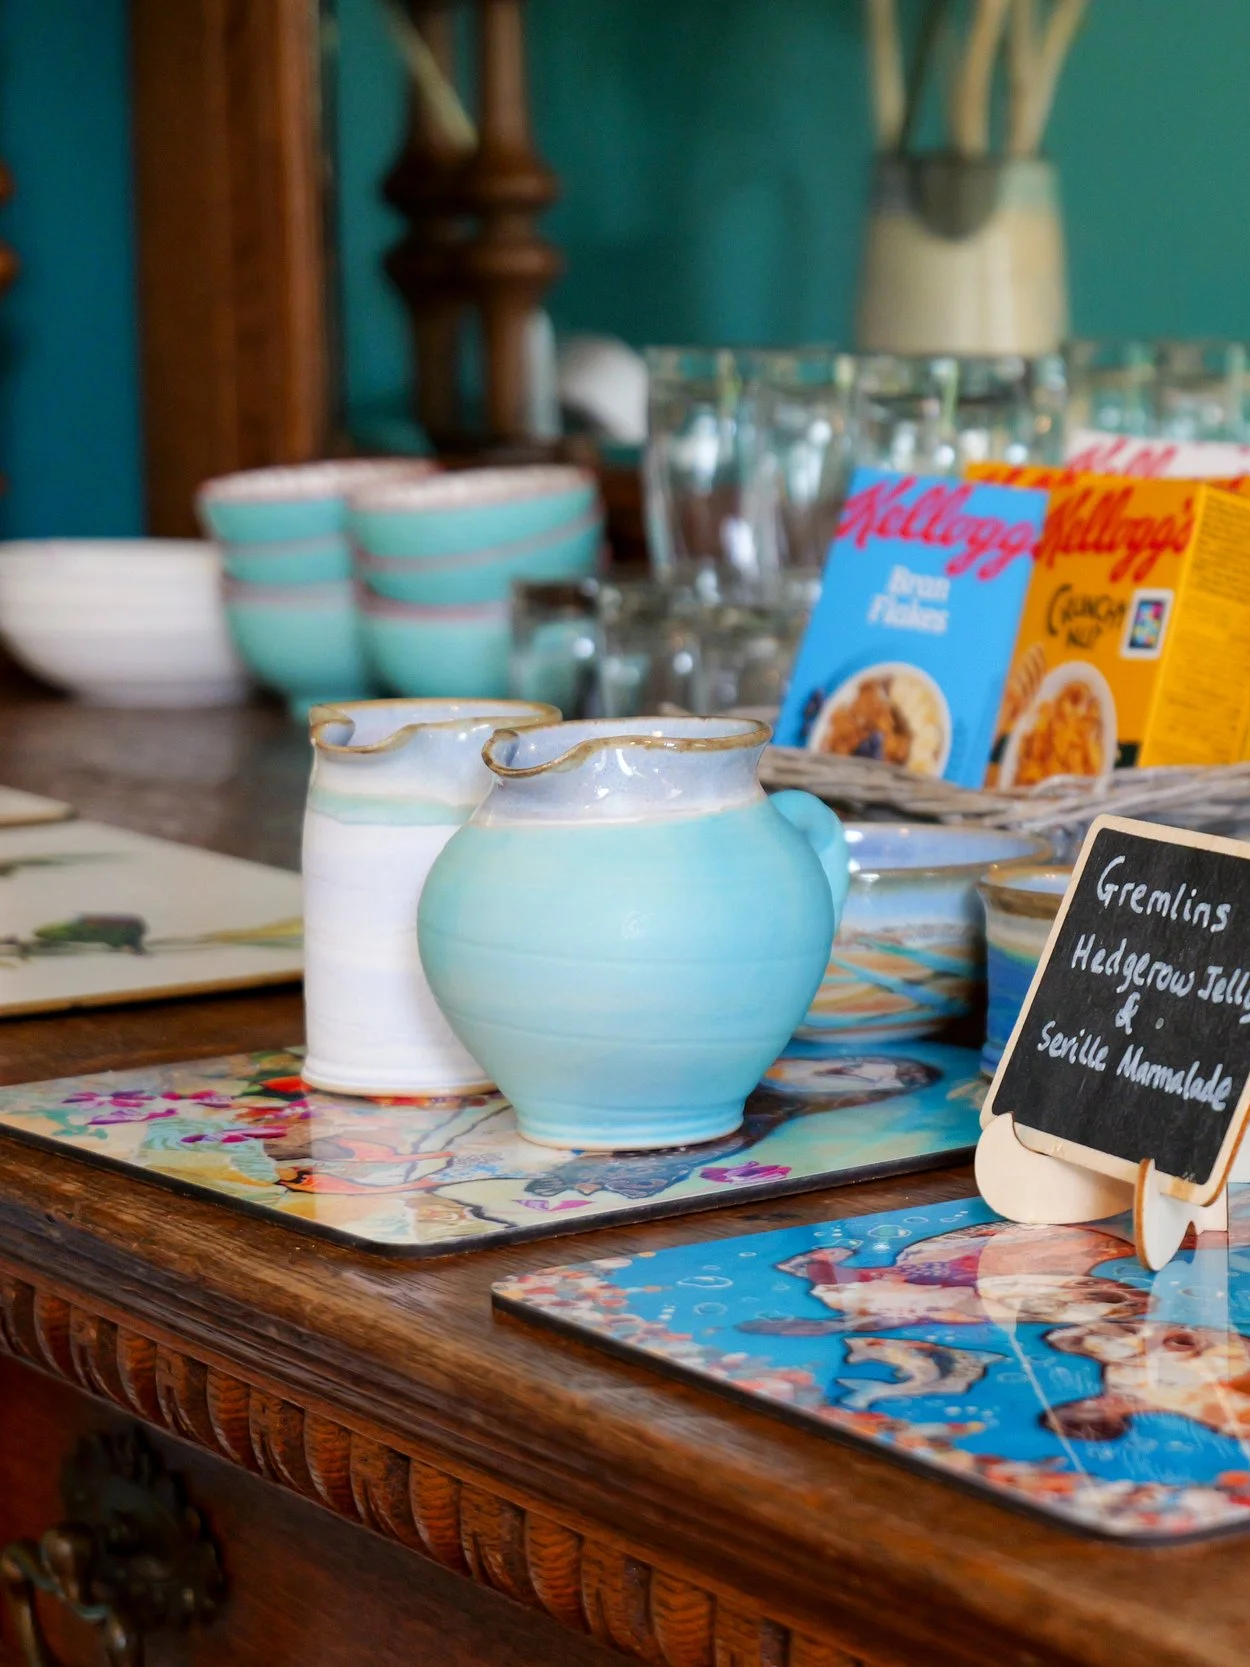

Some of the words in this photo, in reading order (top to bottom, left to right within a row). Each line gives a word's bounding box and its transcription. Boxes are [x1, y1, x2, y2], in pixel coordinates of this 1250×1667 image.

[1097, 855, 1231, 933] Gremlins
[1071, 934, 1195, 997] Hedgerow
[1115, 992, 1141, 1035] &
[1037, 1020, 1109, 1071] Seville
[1116, 1044, 1232, 1111] Marmalade
